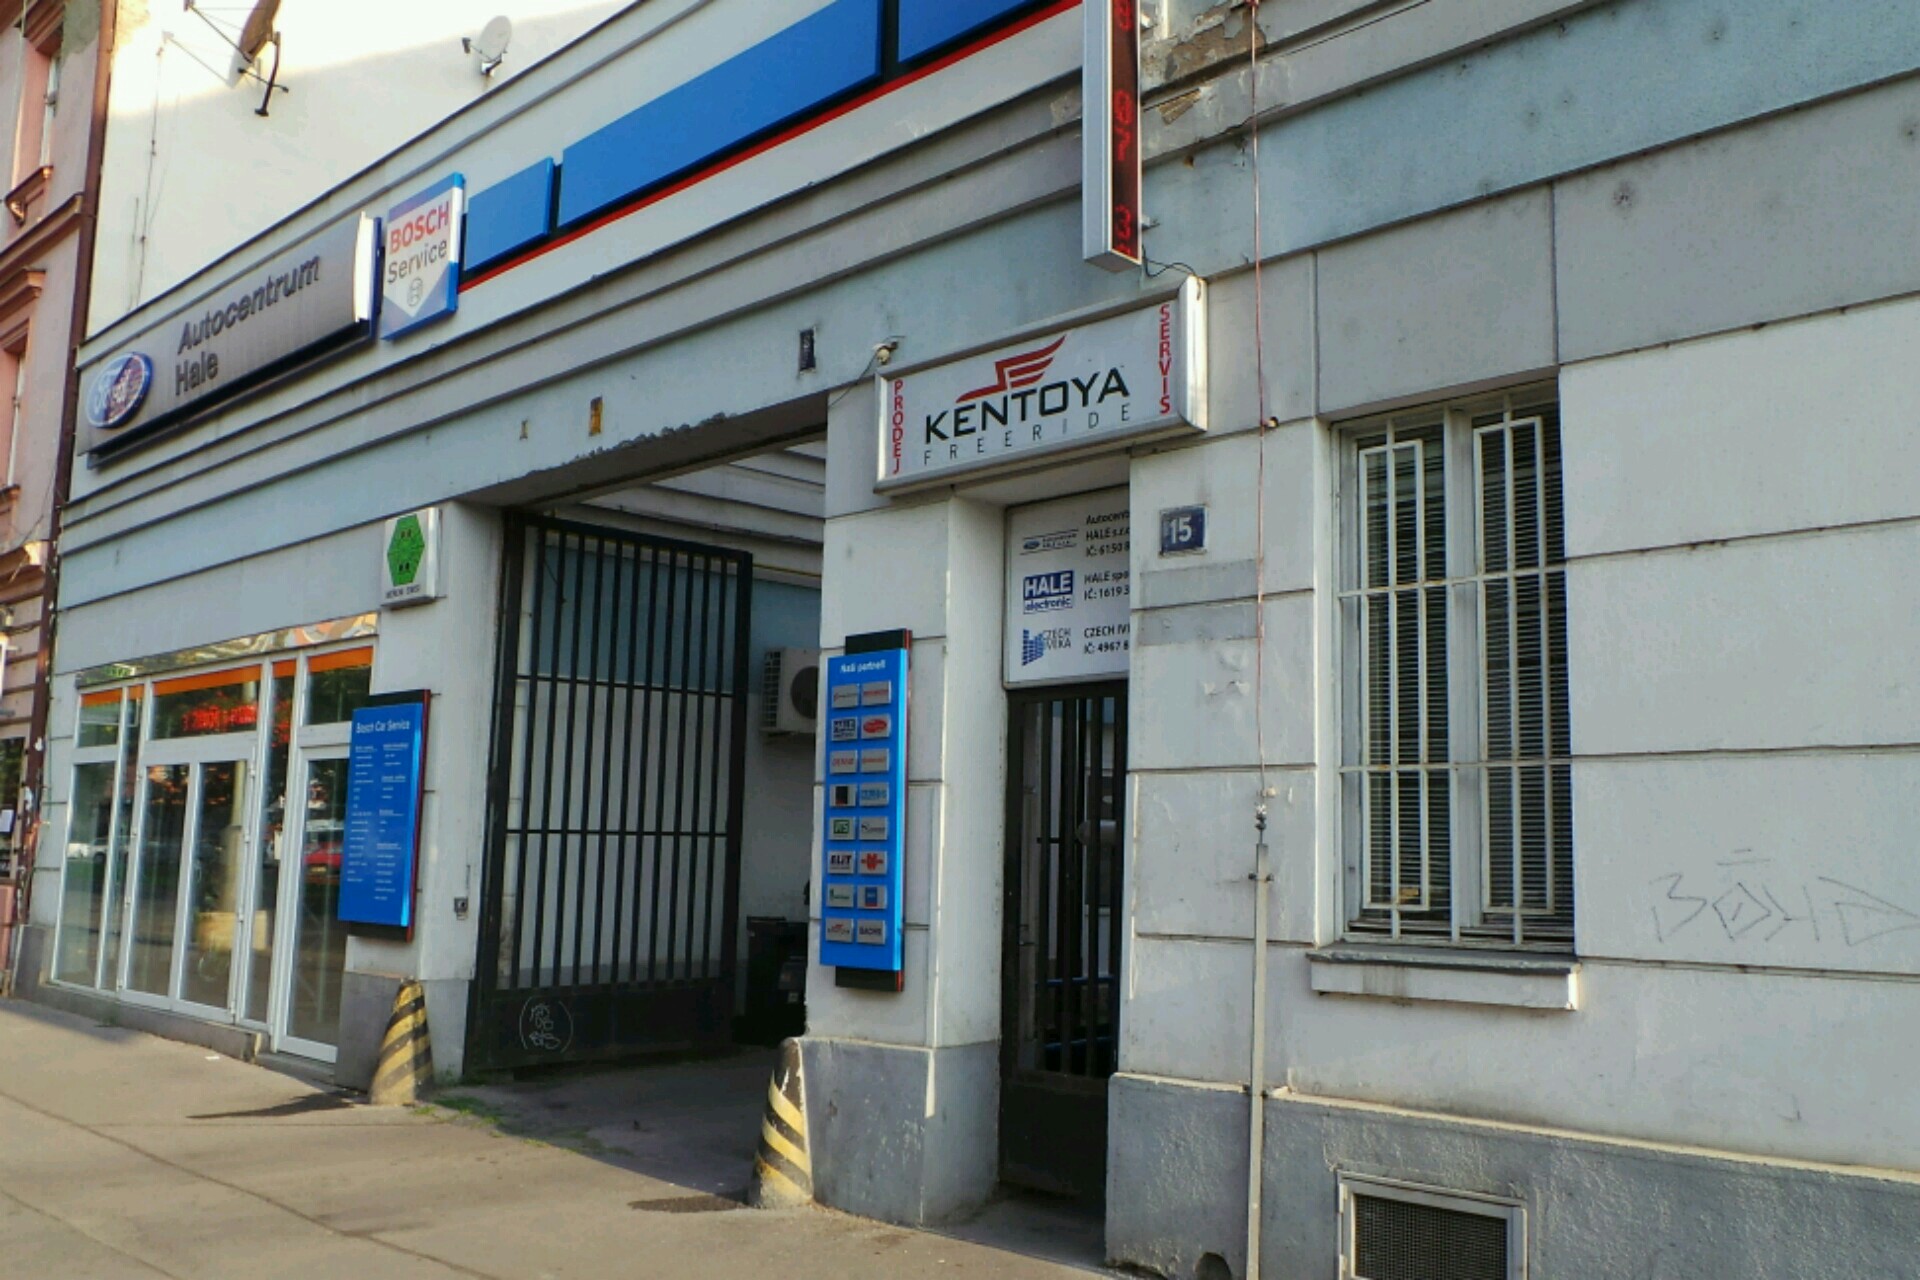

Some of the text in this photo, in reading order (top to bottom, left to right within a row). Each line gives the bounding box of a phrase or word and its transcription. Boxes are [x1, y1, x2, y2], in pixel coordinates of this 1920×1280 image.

[390, 201, 449, 255] BOSCH
[387, 239, 448, 284] Service
[177, 255, 320, 355] Autocentrum
[174, 350, 219, 397] Hale
[1158, 303, 1172, 415] SERVIS
[892, 378, 904, 475] PRODEJ
[925, 367, 1131, 445] KENTOYA
[924, 403, 1131, 466] FREERIDE
[1086, 527, 1111, 541] HALE
[1170, 516, 1193, 545] 15
[1025, 573, 1072, 598] HALE
[1084, 570, 1111, 584] HALE
[1084, 624, 1115, 638] CZECH
